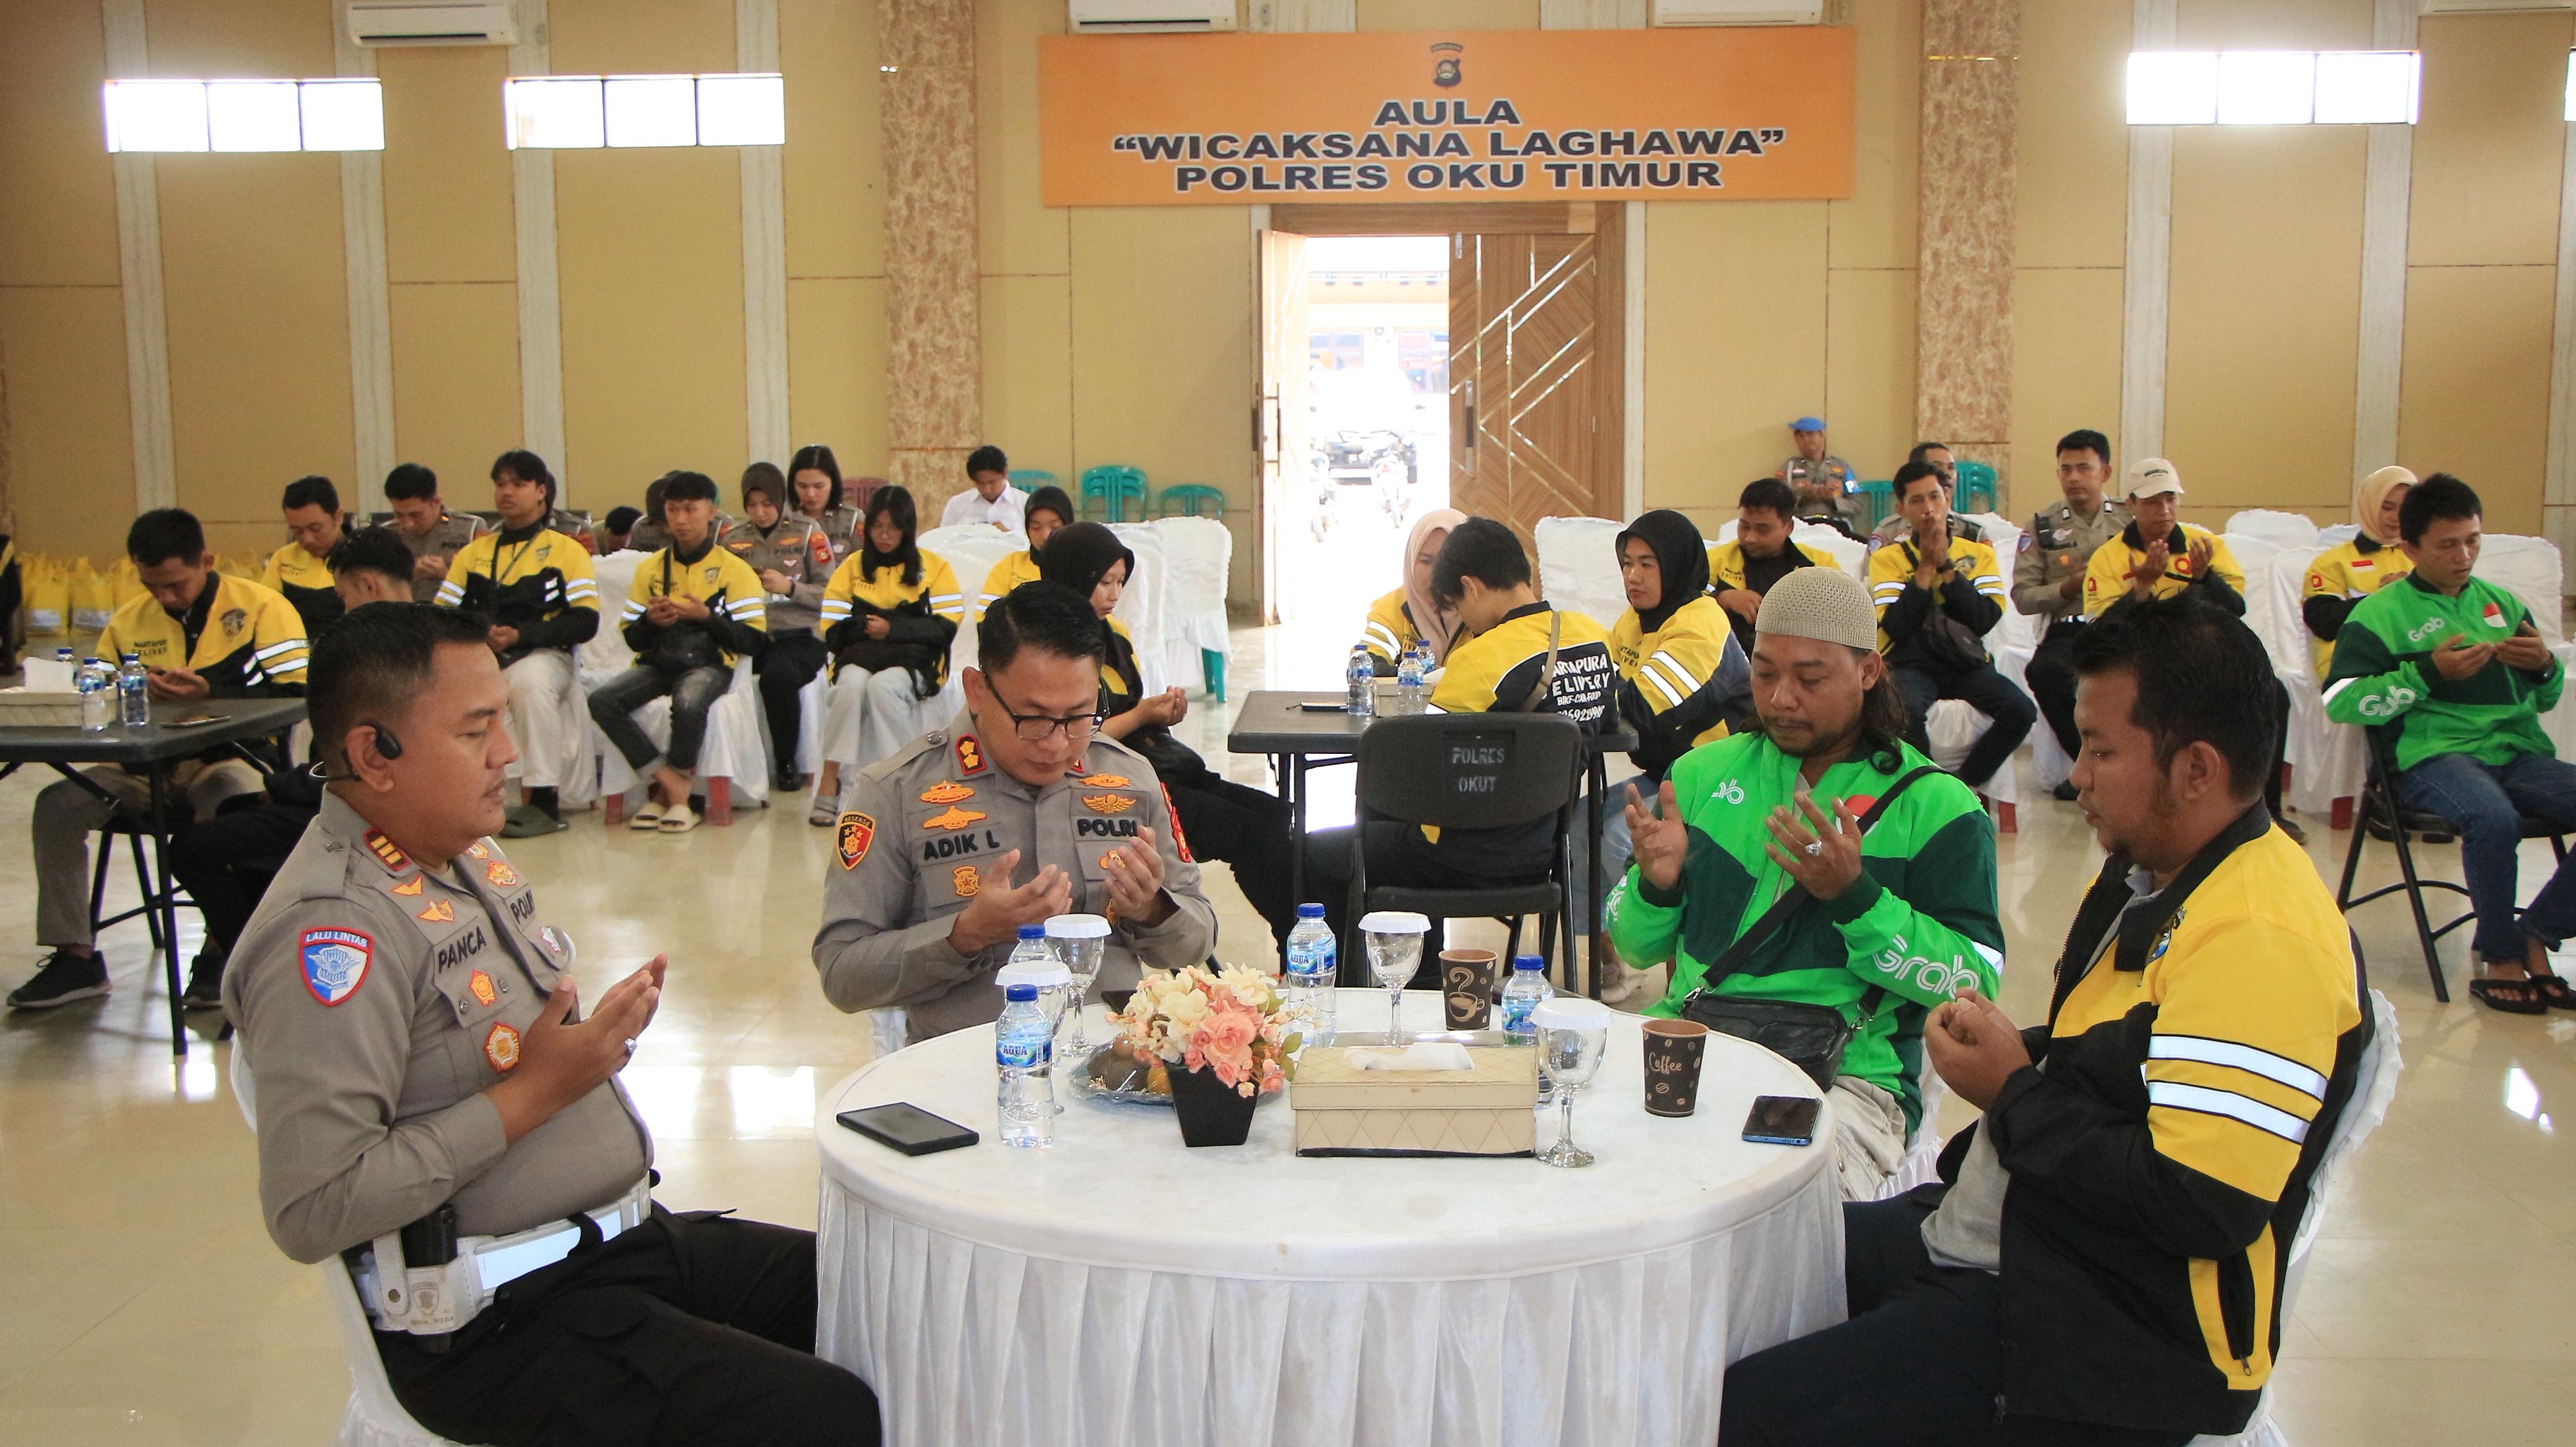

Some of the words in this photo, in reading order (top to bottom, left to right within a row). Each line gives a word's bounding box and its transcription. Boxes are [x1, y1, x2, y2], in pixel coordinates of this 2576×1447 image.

[1373, 100, 1520, 126] AULA
[1176, 164, 1388, 191] POLRES
[1406, 163, 1525, 189] OKU
[1543, 161, 1721, 188] TIMUR
[2408, 616, 2445, 642] Grab
[1541, 654, 1608, 678] ARTAPURA
[1542, 672, 1611, 699] ELIVERY
[1452, 747, 1505, 764] POLRES
[1458, 776, 1497, 792] OKUT
[1077, 818, 1139, 837] POLRI
[923, 833, 978, 861] ADIK
[986, 829, 1000, 849] L
[306, 930, 332, 942] LALU
[438, 925, 487, 974] PANCA
[1289, 953, 1310, 965] AQUA
[1872, 933, 1980, 1000] Grab
[1003, 1044, 1028, 1057] AQUA
[1648, 1051, 1682, 1075] Coffee
